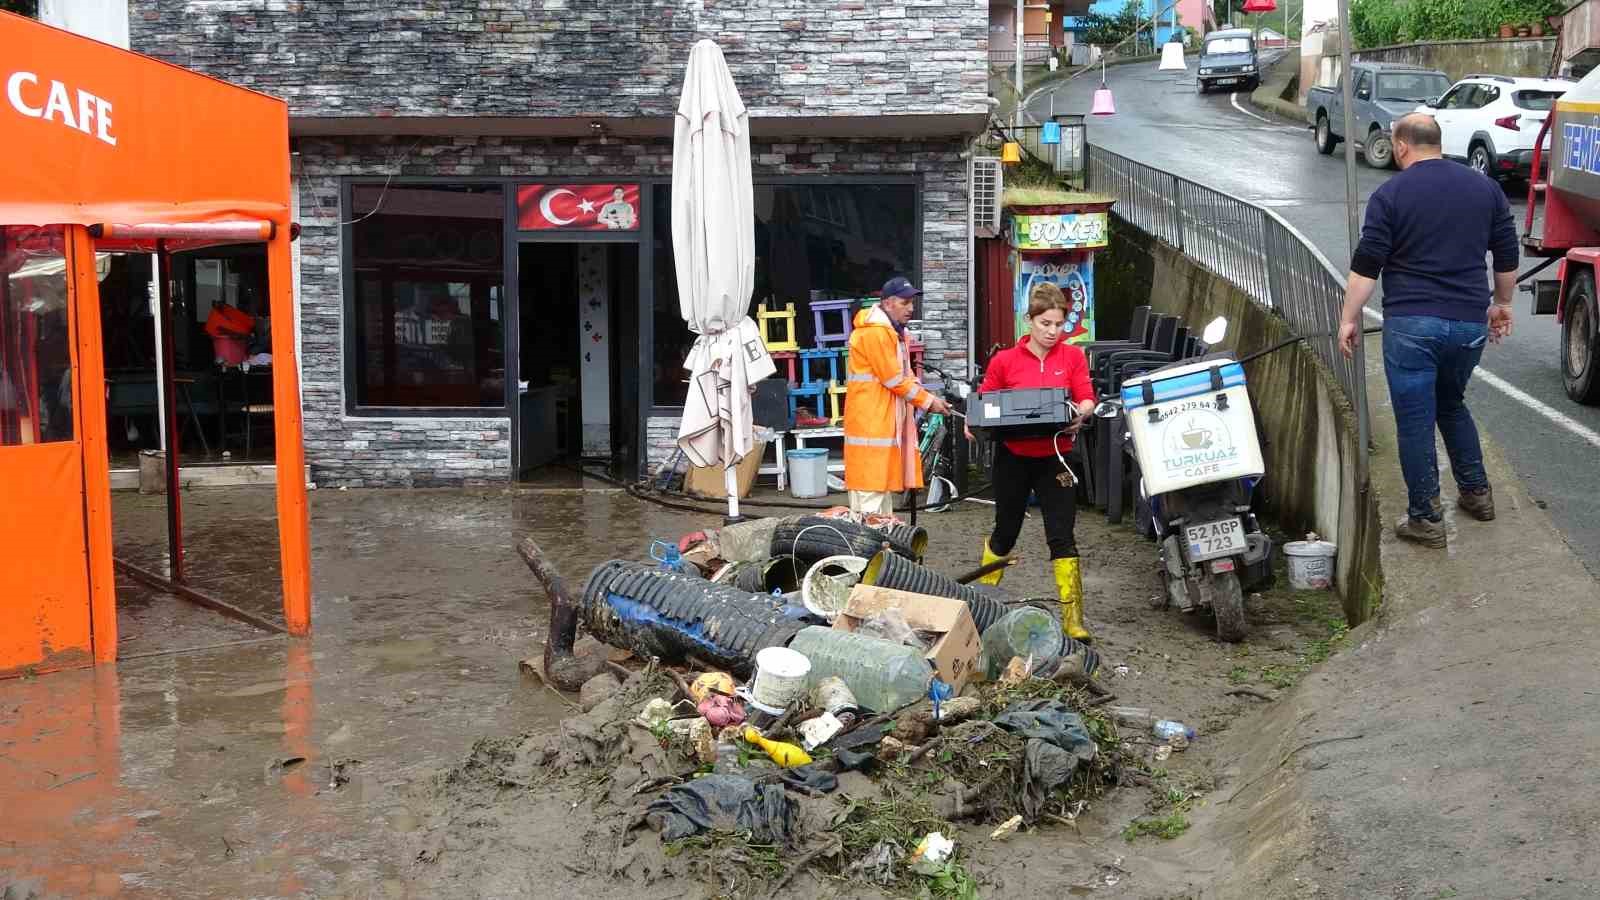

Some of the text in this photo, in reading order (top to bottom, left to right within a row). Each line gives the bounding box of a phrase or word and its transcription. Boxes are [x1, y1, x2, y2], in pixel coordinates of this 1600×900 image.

[7, 71, 118, 146] CAFE
[1029, 219, 1104, 242] BOXER
[1163, 446, 1237, 471] TURKUAZ
[1184, 463, 1221, 478] CAFE
[1188, 520, 1239, 541] 52 AGP
[1204, 536, 1233, 552] 723
